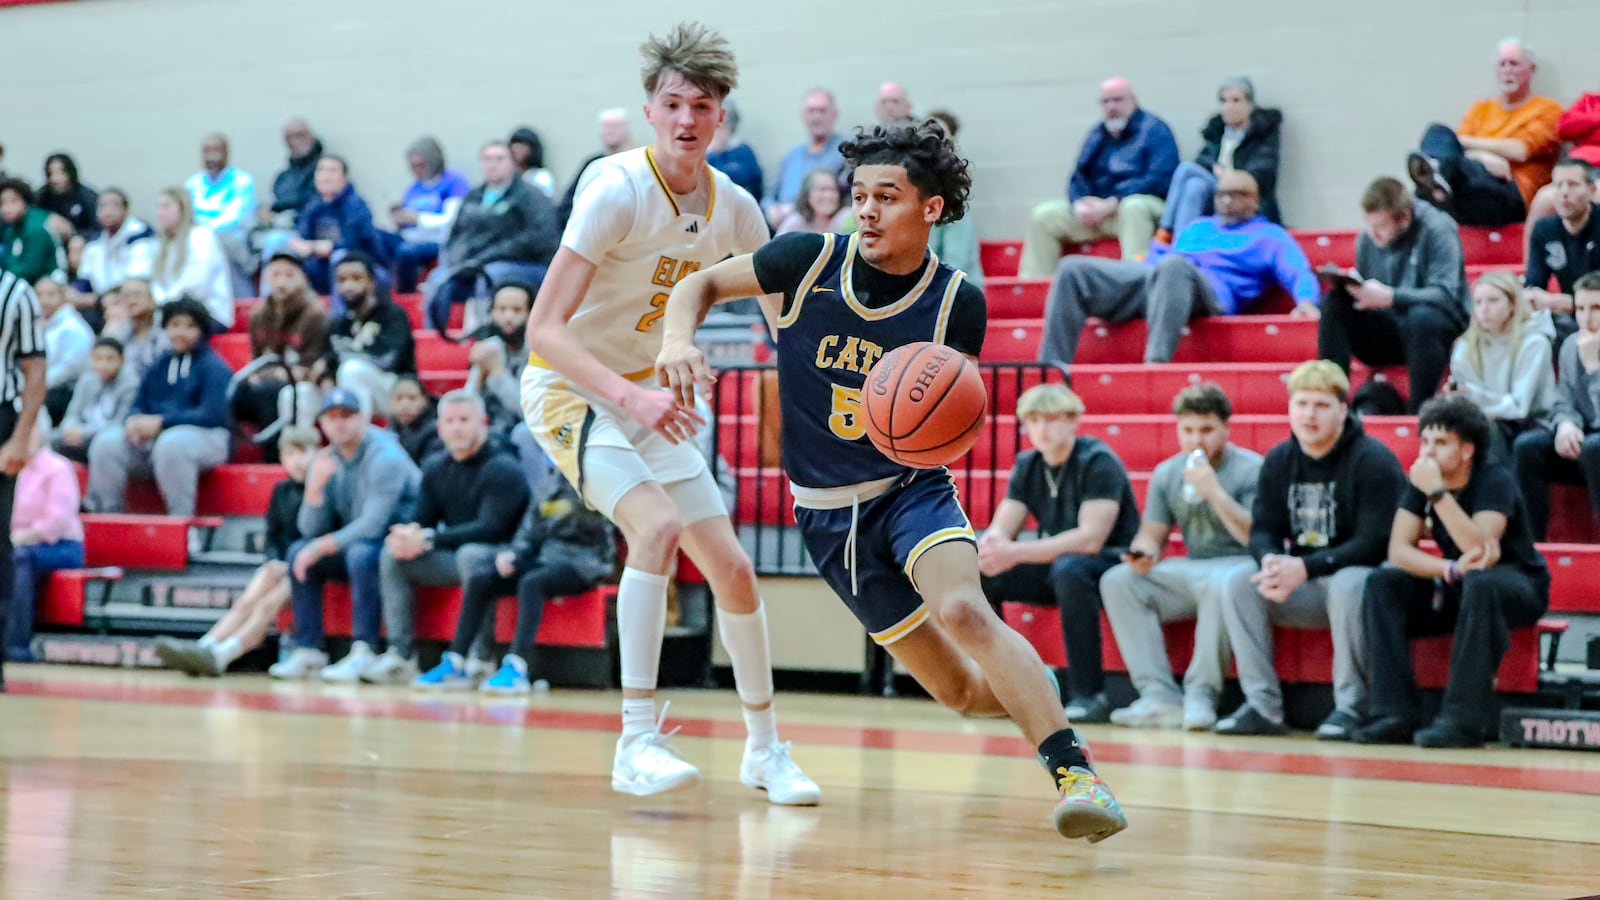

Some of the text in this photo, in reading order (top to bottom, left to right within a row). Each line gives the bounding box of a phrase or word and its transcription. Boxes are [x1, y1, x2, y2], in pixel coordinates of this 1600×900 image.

[634, 292, 670, 332] 2
[815, 335, 889, 376] CAT
[828, 383, 866, 440] 5
